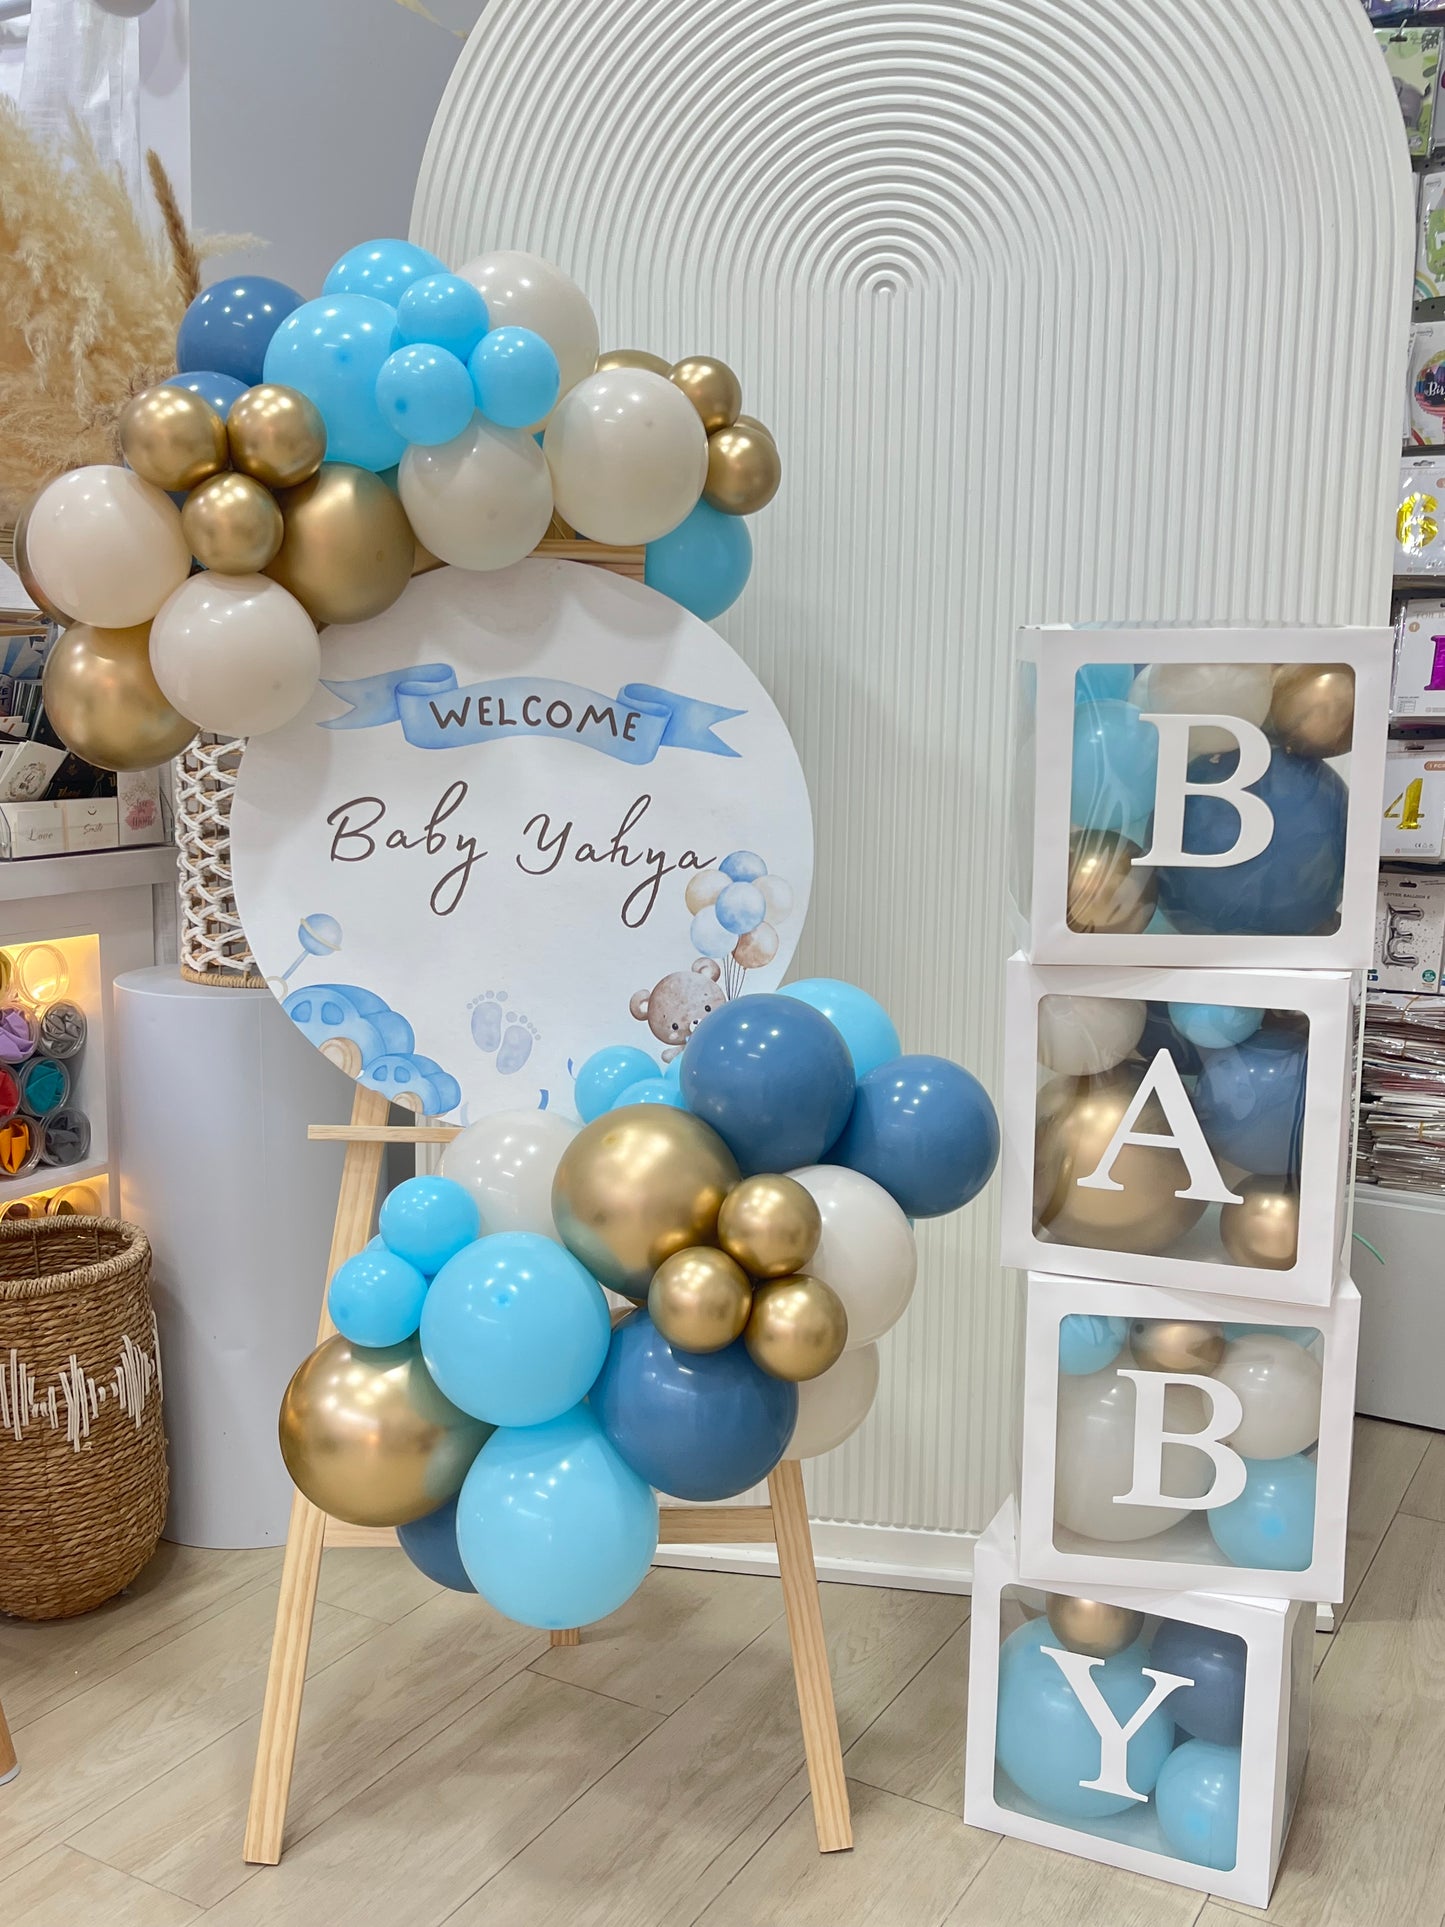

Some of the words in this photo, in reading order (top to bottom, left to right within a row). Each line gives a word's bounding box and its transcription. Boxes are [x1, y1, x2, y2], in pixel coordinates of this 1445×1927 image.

[429, 695, 641, 741] WELCOME
[1131, 713, 1274, 868] B
[327, 780, 488, 916] Baby
[516, 794, 717, 928] Yahya
[1383, 777, 1425, 830] 4
[1077, 1048, 1244, 1205] A
[1113, 1369, 1247, 1511] B
[1040, 1645, 1195, 1803] Y
